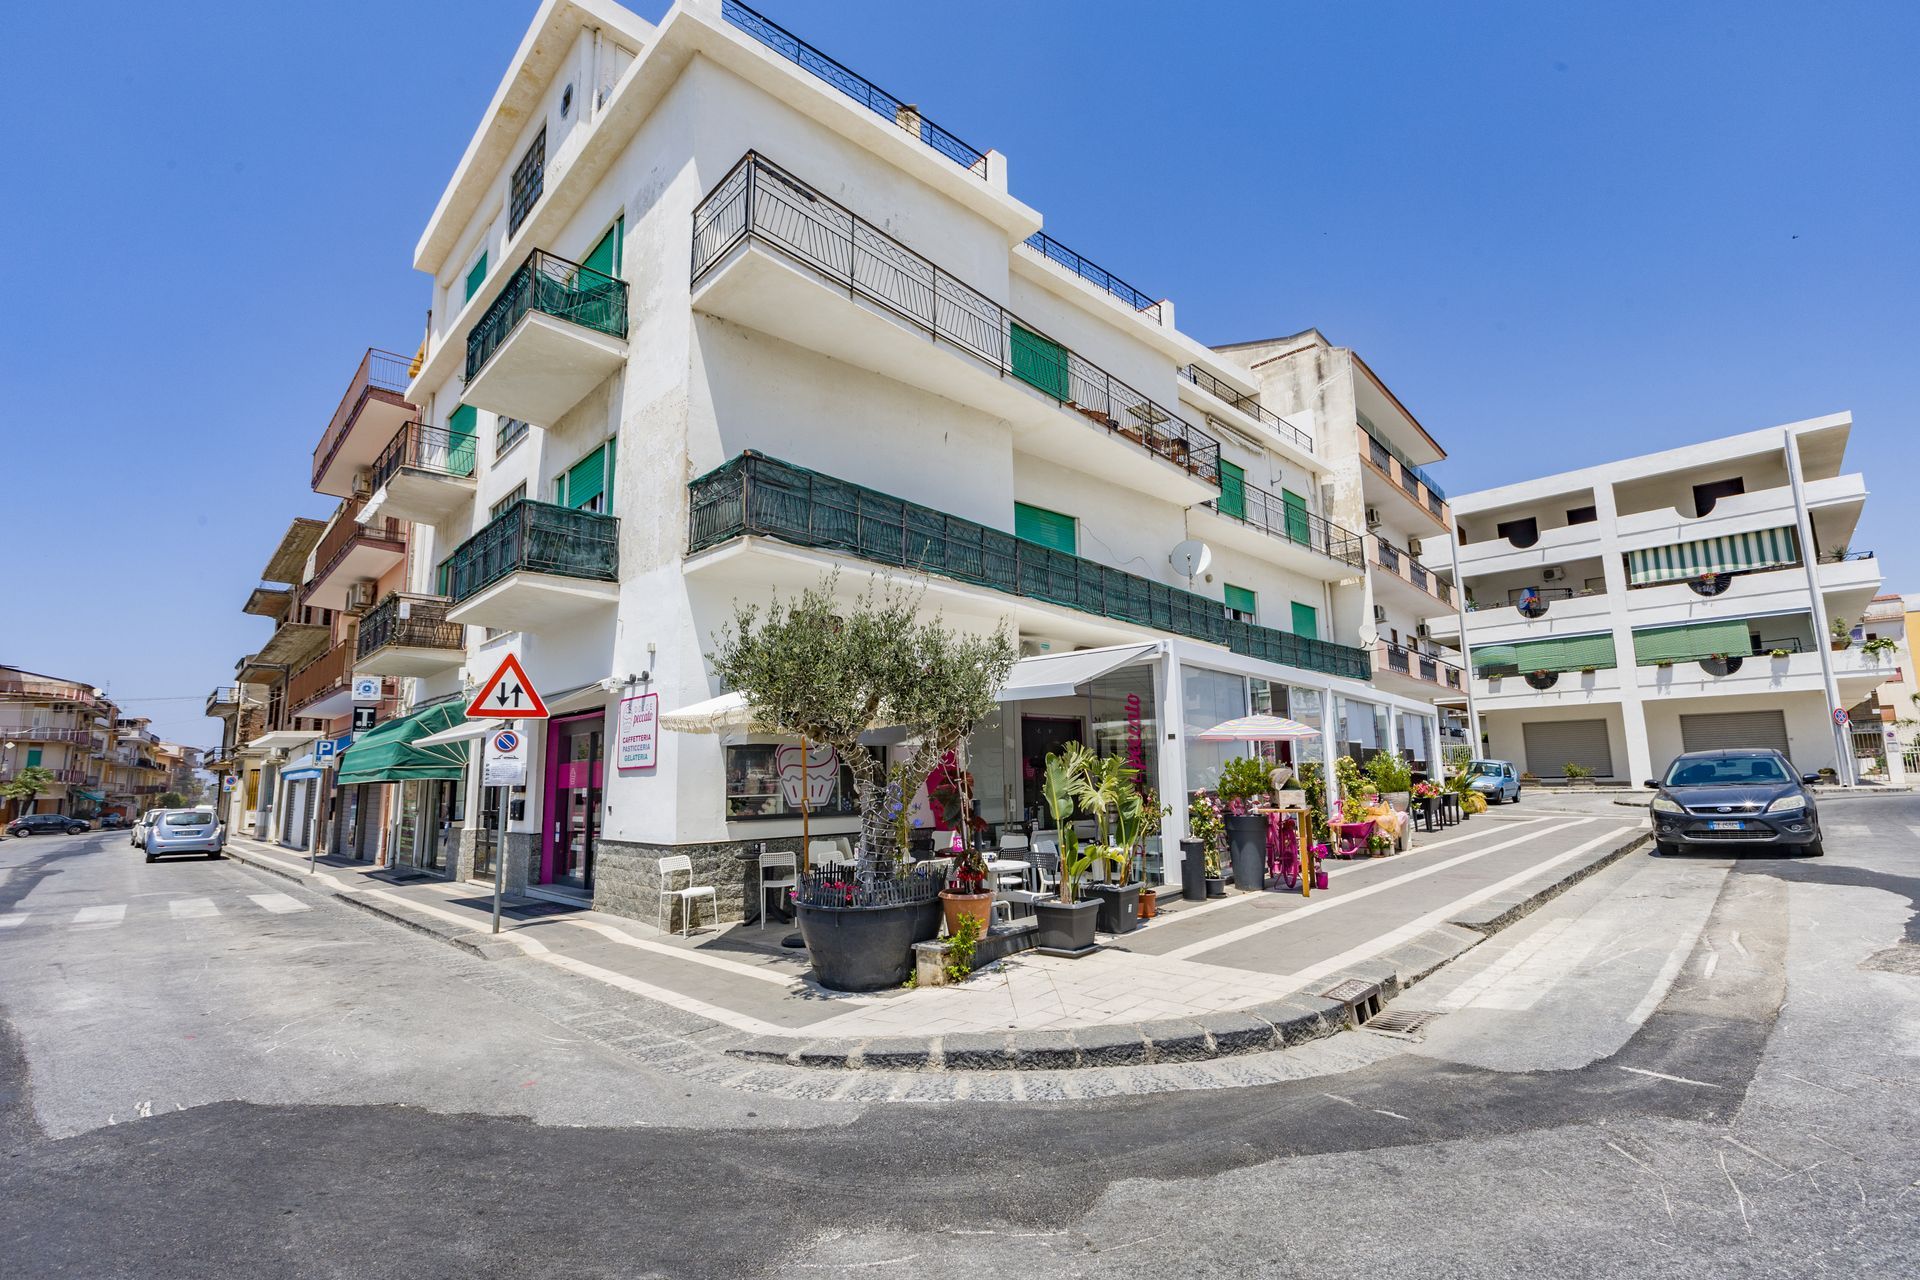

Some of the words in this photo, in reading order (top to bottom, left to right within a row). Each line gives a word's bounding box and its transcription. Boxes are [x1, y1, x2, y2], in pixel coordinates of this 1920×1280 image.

[632, 711, 653, 727] peccato
[1124, 692, 1147, 770] peccato
[622, 734, 651, 744] CAFFETTERIA
[318, 743, 331, 755] P
[622, 743, 650, 753] PASTICCERIA
[624, 753, 648, 762] GELATERIA
